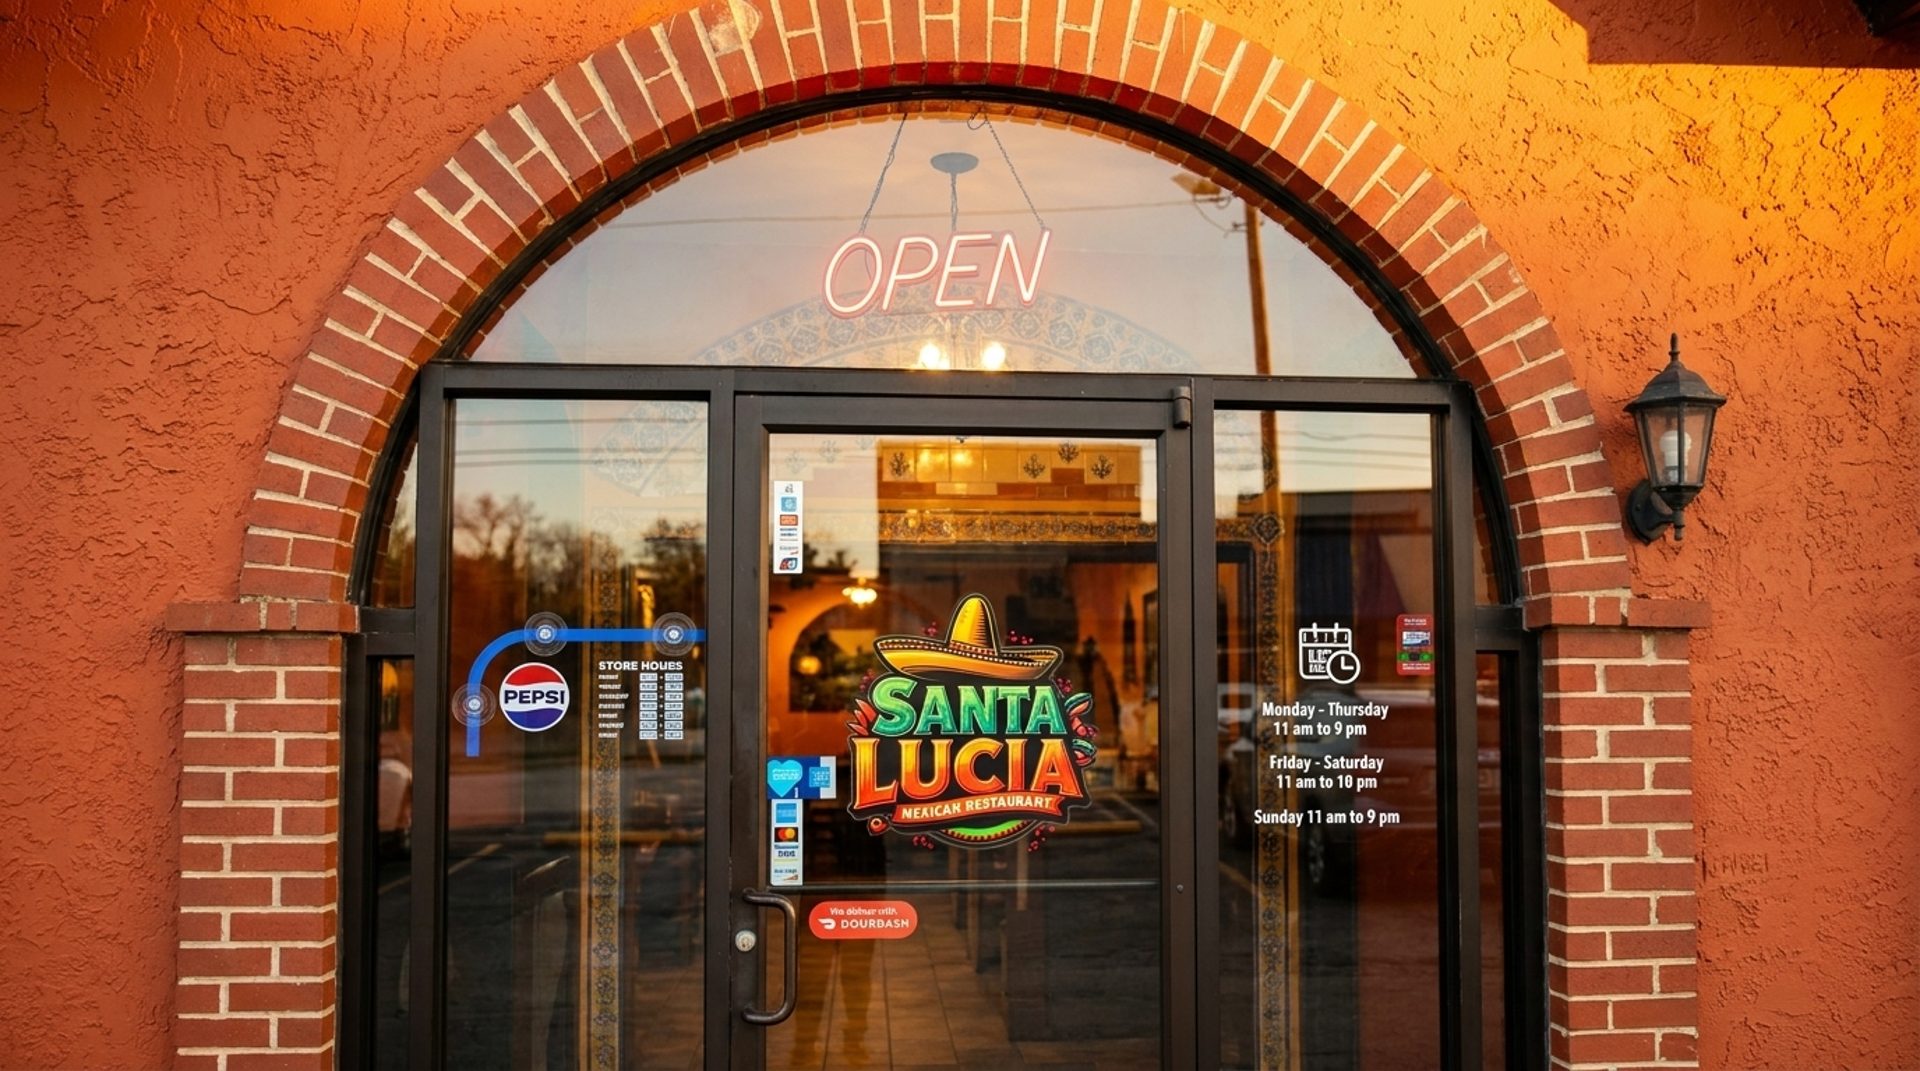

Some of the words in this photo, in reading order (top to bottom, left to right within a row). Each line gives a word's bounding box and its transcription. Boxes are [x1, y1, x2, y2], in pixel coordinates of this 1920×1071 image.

[823, 229, 1051, 318] OPEN
[598, 660, 639, 671] STORE
[503, 689, 566, 705] PEPSI
[871, 676, 1068, 737] SANTA
[1262, 702, 1315, 720] Monday
[1328, 702, 1389, 720] Thursday
[1273, 722, 1288, 735] 11
[1293, 725, 1313, 735] am
[1317, 722, 1331, 735] to
[1334, 722, 1343, 735] 9
[1346, 725, 1367, 739] pm
[1323, 754, 1384, 773] Saturday
[852, 737, 1083, 810] LUCIA
[1276, 775, 1291, 788] 11
[1296, 778, 1316, 788] am
[1319, 775, 1333, 788] to
[1337, 775, 1353, 788] 10
[1356, 778, 1377, 792] pm
[1254, 809, 1303, 827] Sunday
[1307, 810, 1322, 823] 11
[1326, 813, 1347, 824] am
[1350, 810, 1364, 824] to
[1367, 810, 1376, 824] 9
[1379, 813, 1400, 827] pm
